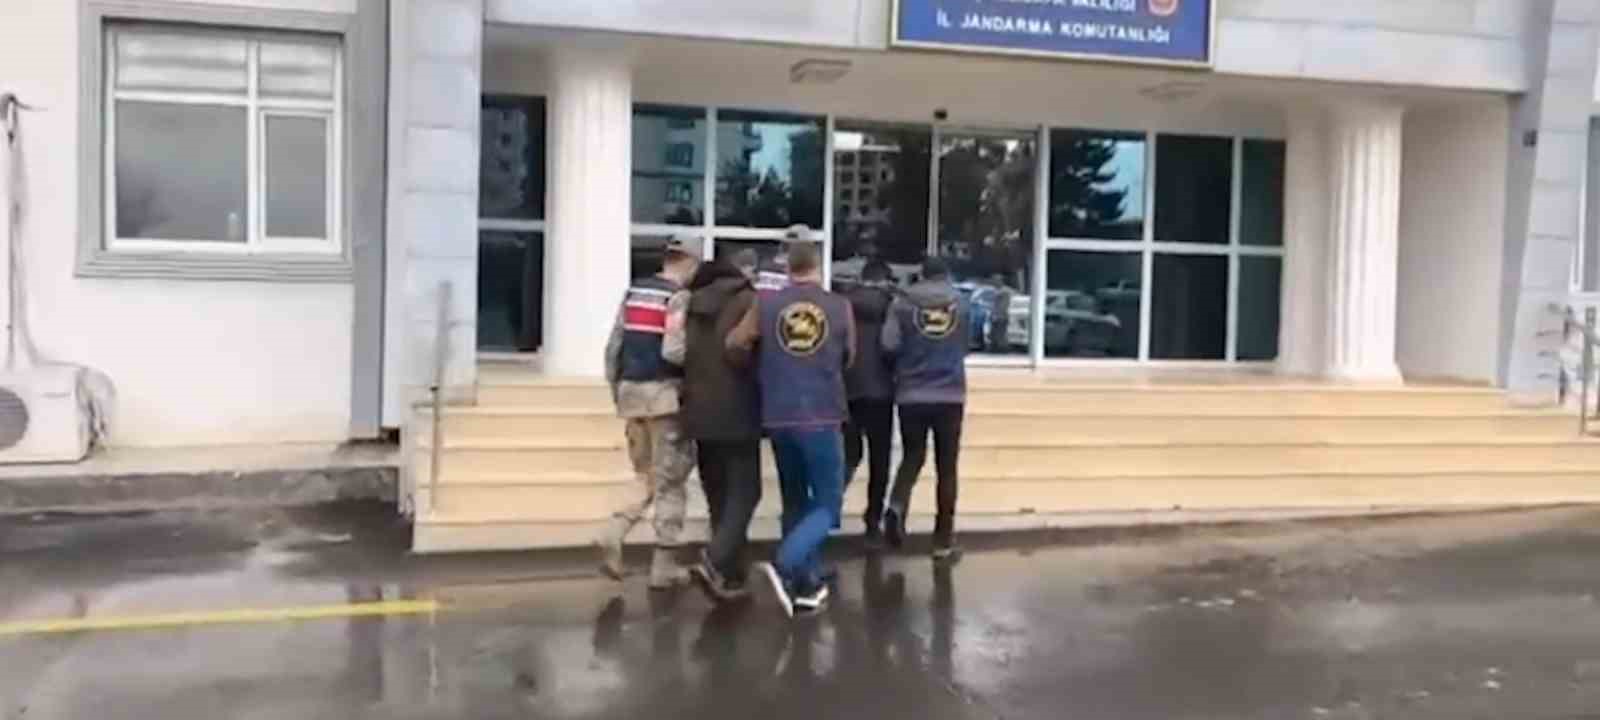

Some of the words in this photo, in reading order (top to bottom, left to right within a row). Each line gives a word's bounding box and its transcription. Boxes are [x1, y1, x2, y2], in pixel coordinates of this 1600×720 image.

[936, 8, 951, 28] İL
[961, 13, 1052, 34] JANDARMA
[1060, 22, 1170, 43] KOMUTANLIĞI
